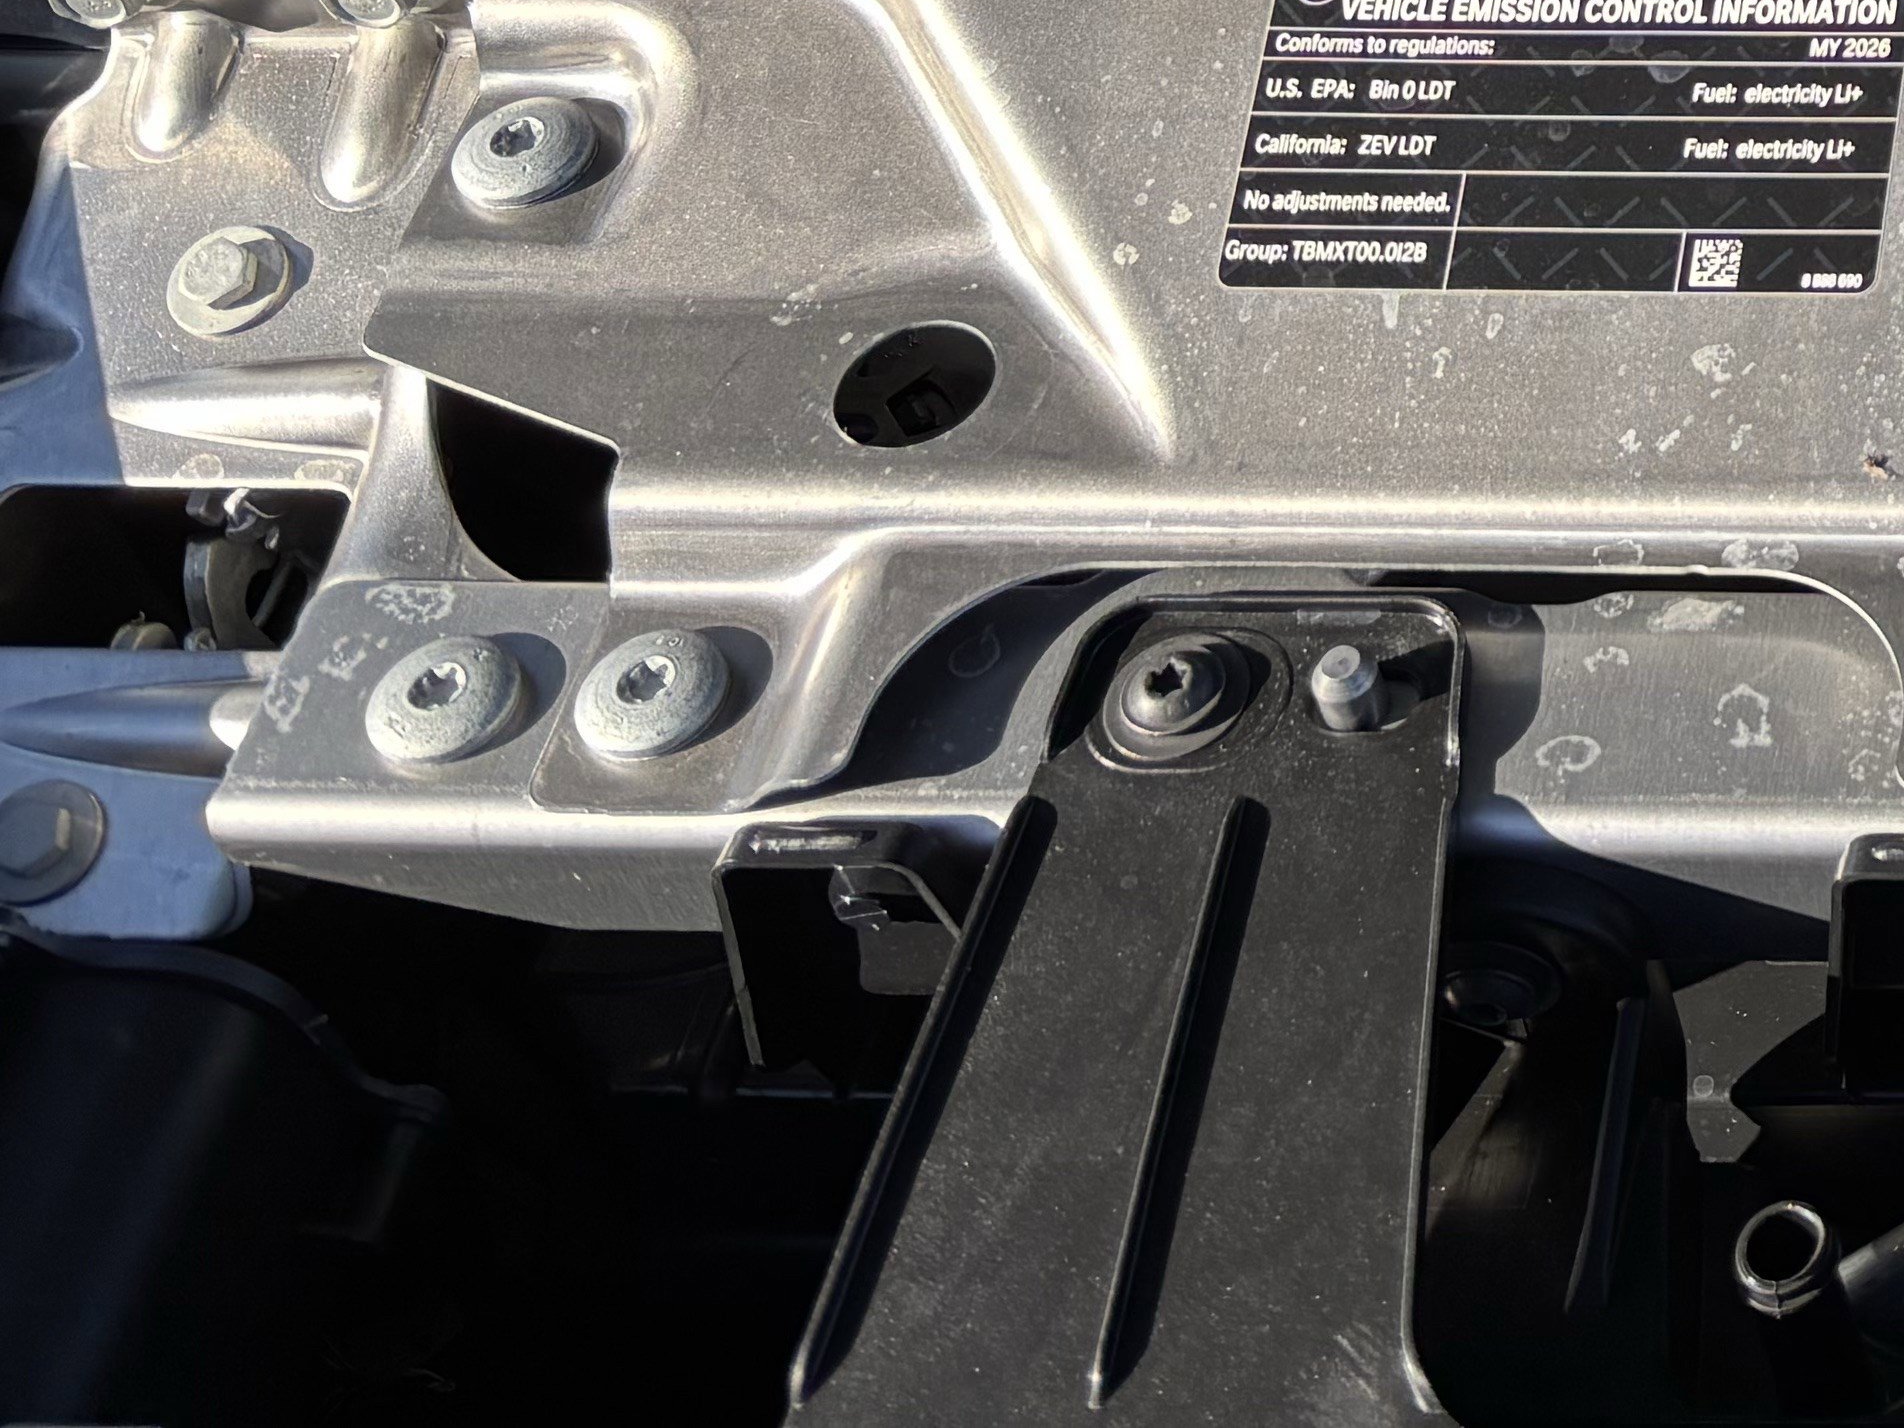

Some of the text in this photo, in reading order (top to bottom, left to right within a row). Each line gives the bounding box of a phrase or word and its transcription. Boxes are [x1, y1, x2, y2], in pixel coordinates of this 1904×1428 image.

[1712, 0, 1897, 24] INFORMATION
[1276, 34, 1495, 57] Conforms to regulations:
[1809, 38, 1891, 58] MY 2026
[1266, 79, 1302, 98] U.S.
[1311, 79, 1355, 99] EPA:
[1369, 80, 1399, 99] Bin
[1418, 81, 1455, 100] LDT
[1692, 83, 1863, 107] Fuel: electricity Li+
[1255, 133, 1436, 155] California: ZEV LDT
[1683, 138, 1855, 163] Fuel: electricity Li+
[1243, 190, 1450, 214] No adjustments needed.
[1224, 241, 1288, 264] Group:
